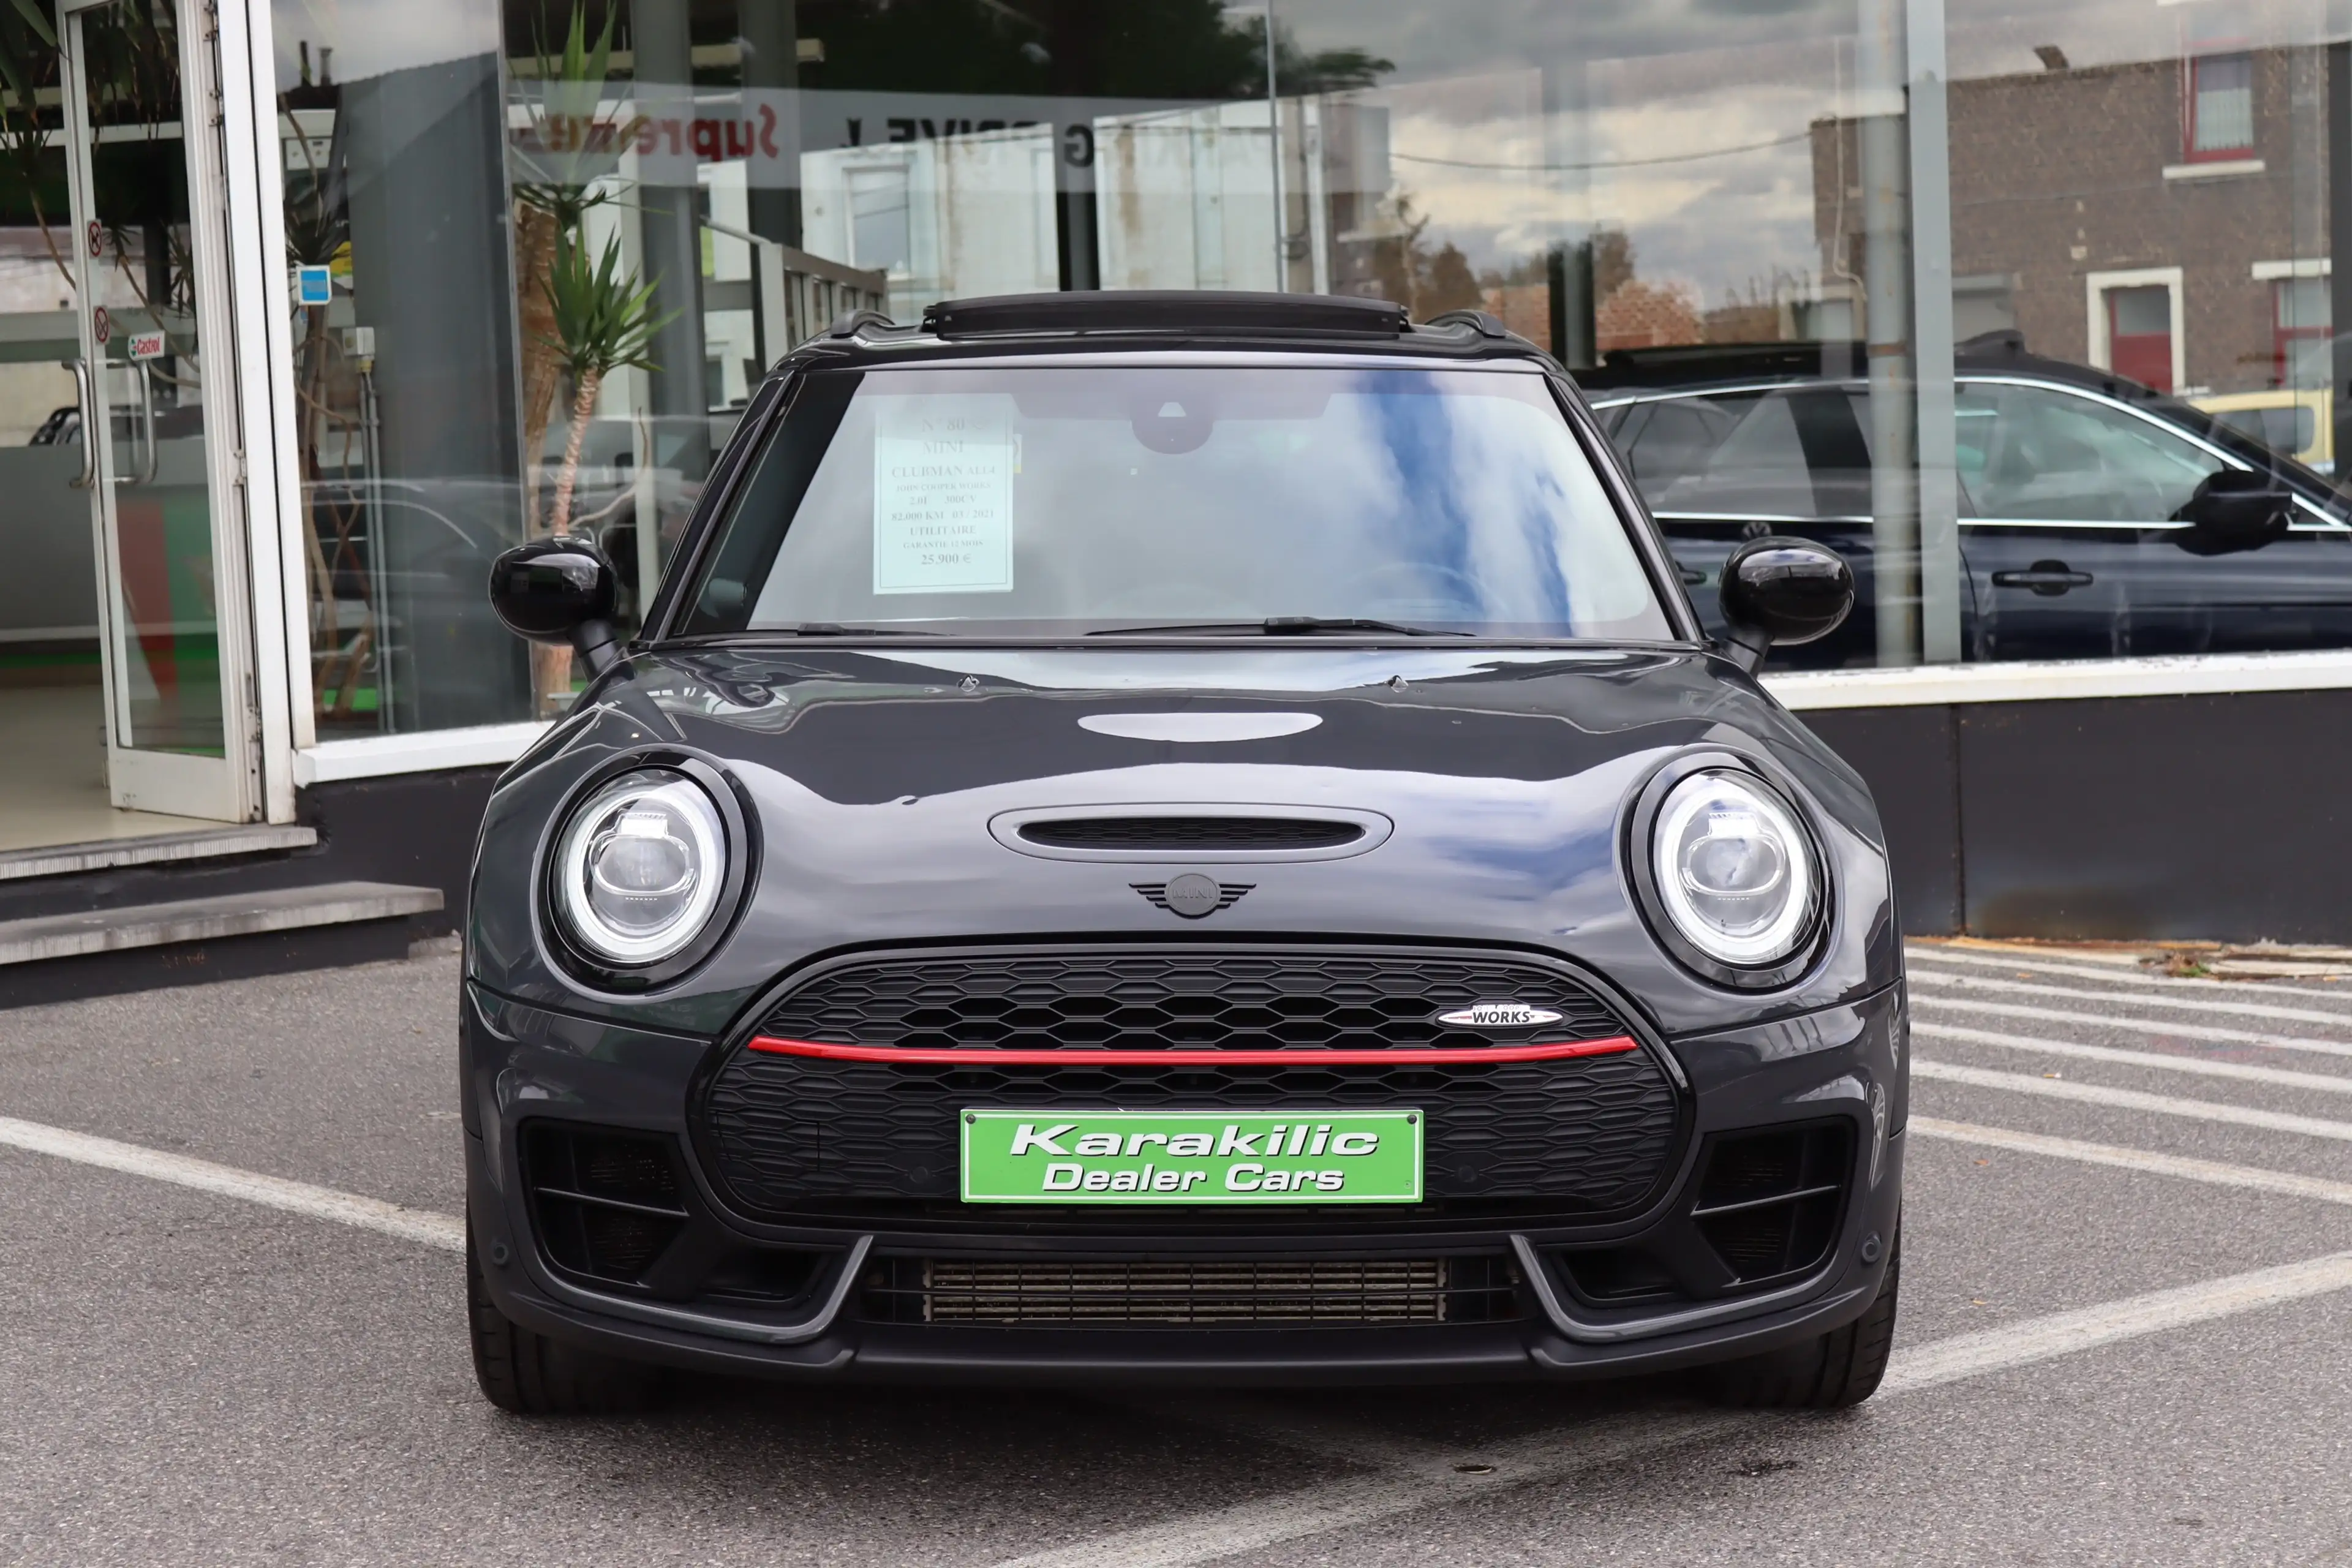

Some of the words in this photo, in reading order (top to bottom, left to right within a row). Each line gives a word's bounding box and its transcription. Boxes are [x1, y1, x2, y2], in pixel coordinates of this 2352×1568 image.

[923, 440, 963, 455] MINI
[891, 465, 963, 478] CLUBMAN
[921, 483, 957, 492] COOPER
[925, 511, 944, 521] KM
[973, 509, 994, 519] 2021
[910, 525, 976, 537] UTILITAIRE
[903, 540, 946, 549] GARANTIE
[960, 539, 984, 548] MOIS
[1172, 886, 1213, 899] MINI
[1472, 1011, 1530, 1023] WORKS
[1009, 1124, 1379, 1157] Karakilic
[1041, 1163, 1206, 1192] Dealer
[1225, 1163, 1345, 1192] Cars
